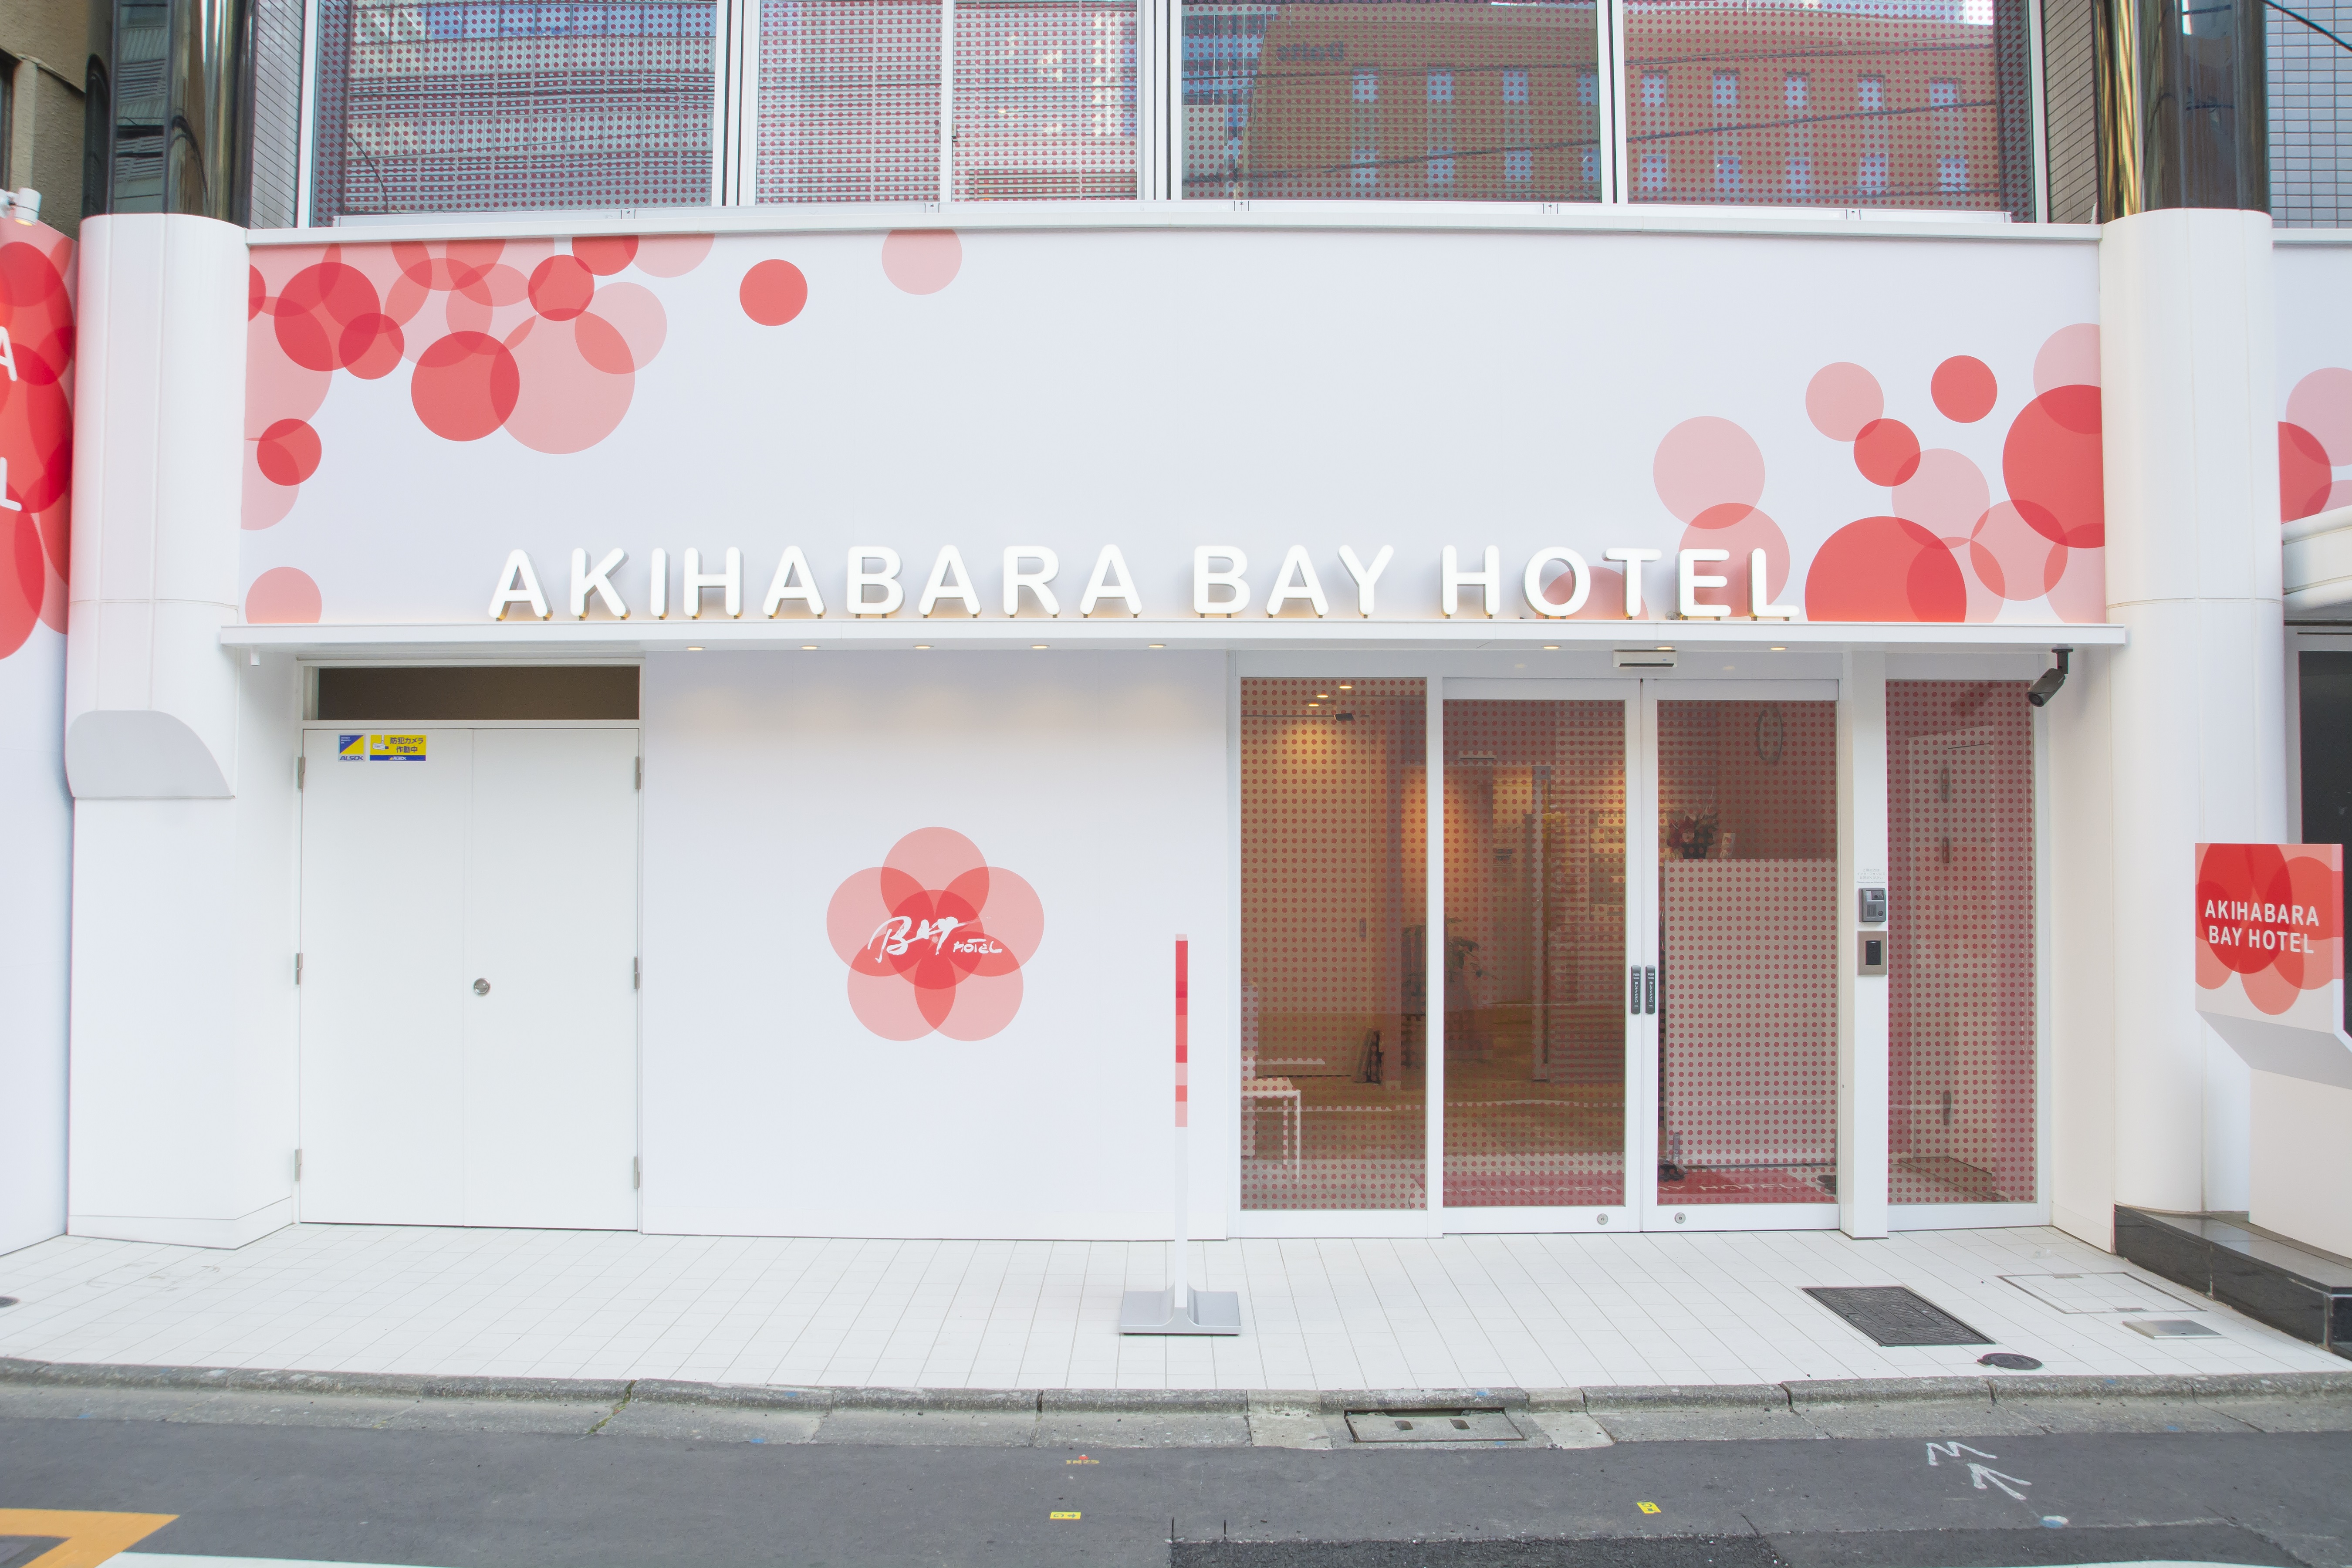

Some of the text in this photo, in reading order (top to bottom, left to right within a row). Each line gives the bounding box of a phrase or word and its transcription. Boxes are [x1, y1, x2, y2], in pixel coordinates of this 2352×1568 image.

[488, 544, 1801, 619] AKIHABARA BAY HOTEL
[2205, 899, 2319, 926] AKIHABARA
[953, 939, 1002, 953] HOTEL
[2209, 926, 2314, 954] BAY HOTEL
